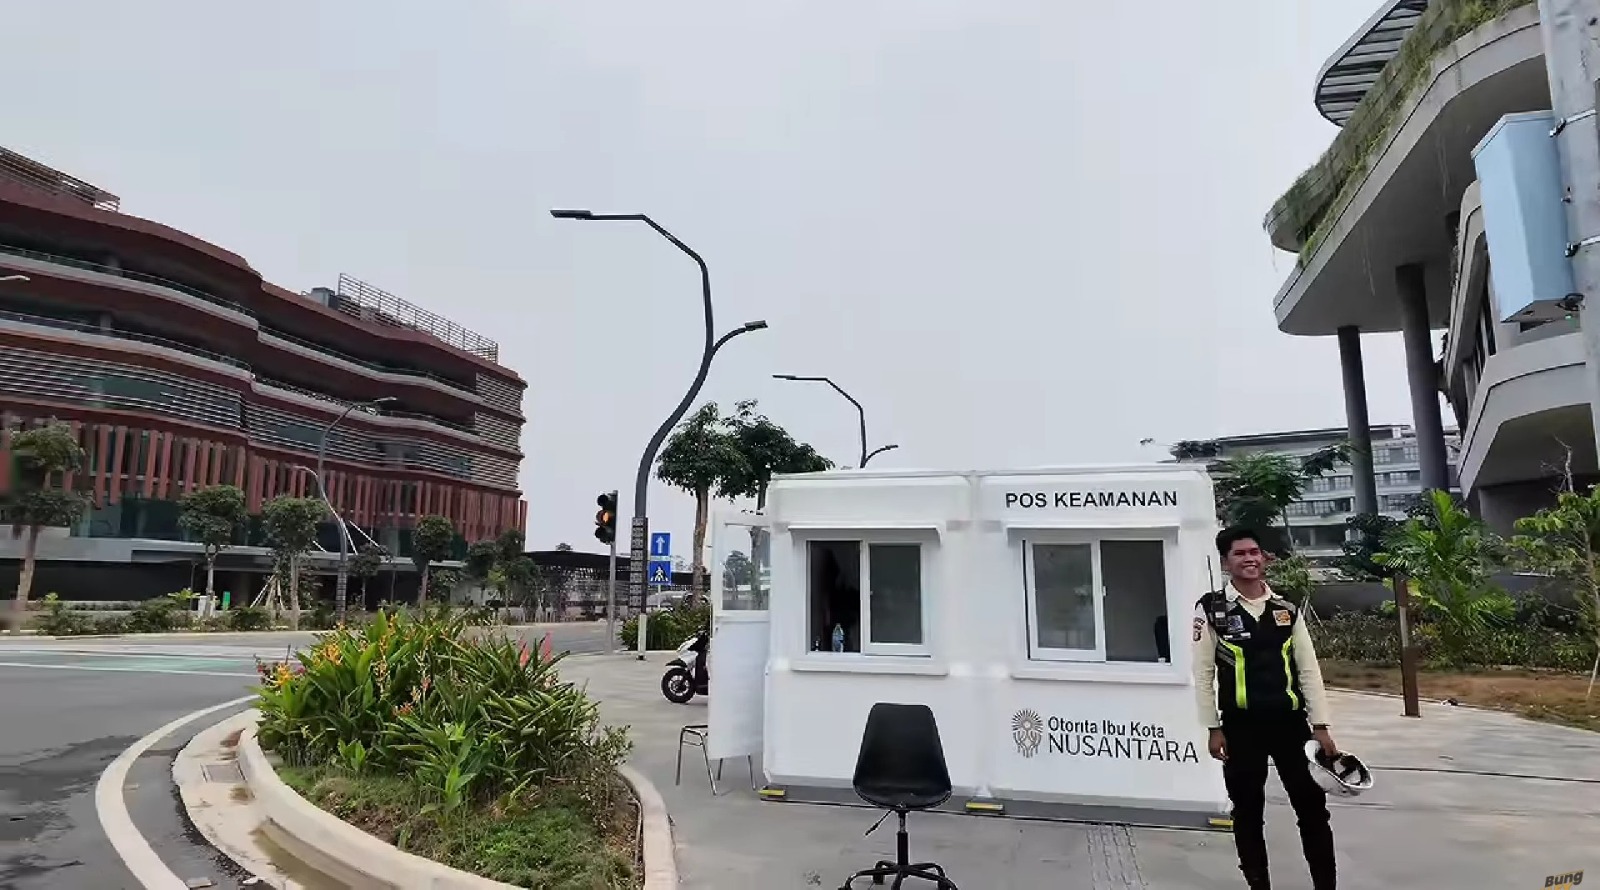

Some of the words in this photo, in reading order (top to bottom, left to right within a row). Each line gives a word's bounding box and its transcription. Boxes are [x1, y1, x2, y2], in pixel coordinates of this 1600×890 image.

[1005, 492, 1047, 508] POS
[1054, 490, 1178, 508] KEAMANAN
[1048, 716, 1098, 734] Otorita
[1102, 719, 1126, 736] Ibu
[1130, 721, 1165, 738] Kota
[1049, 733, 1199, 763] NUSANTARA
